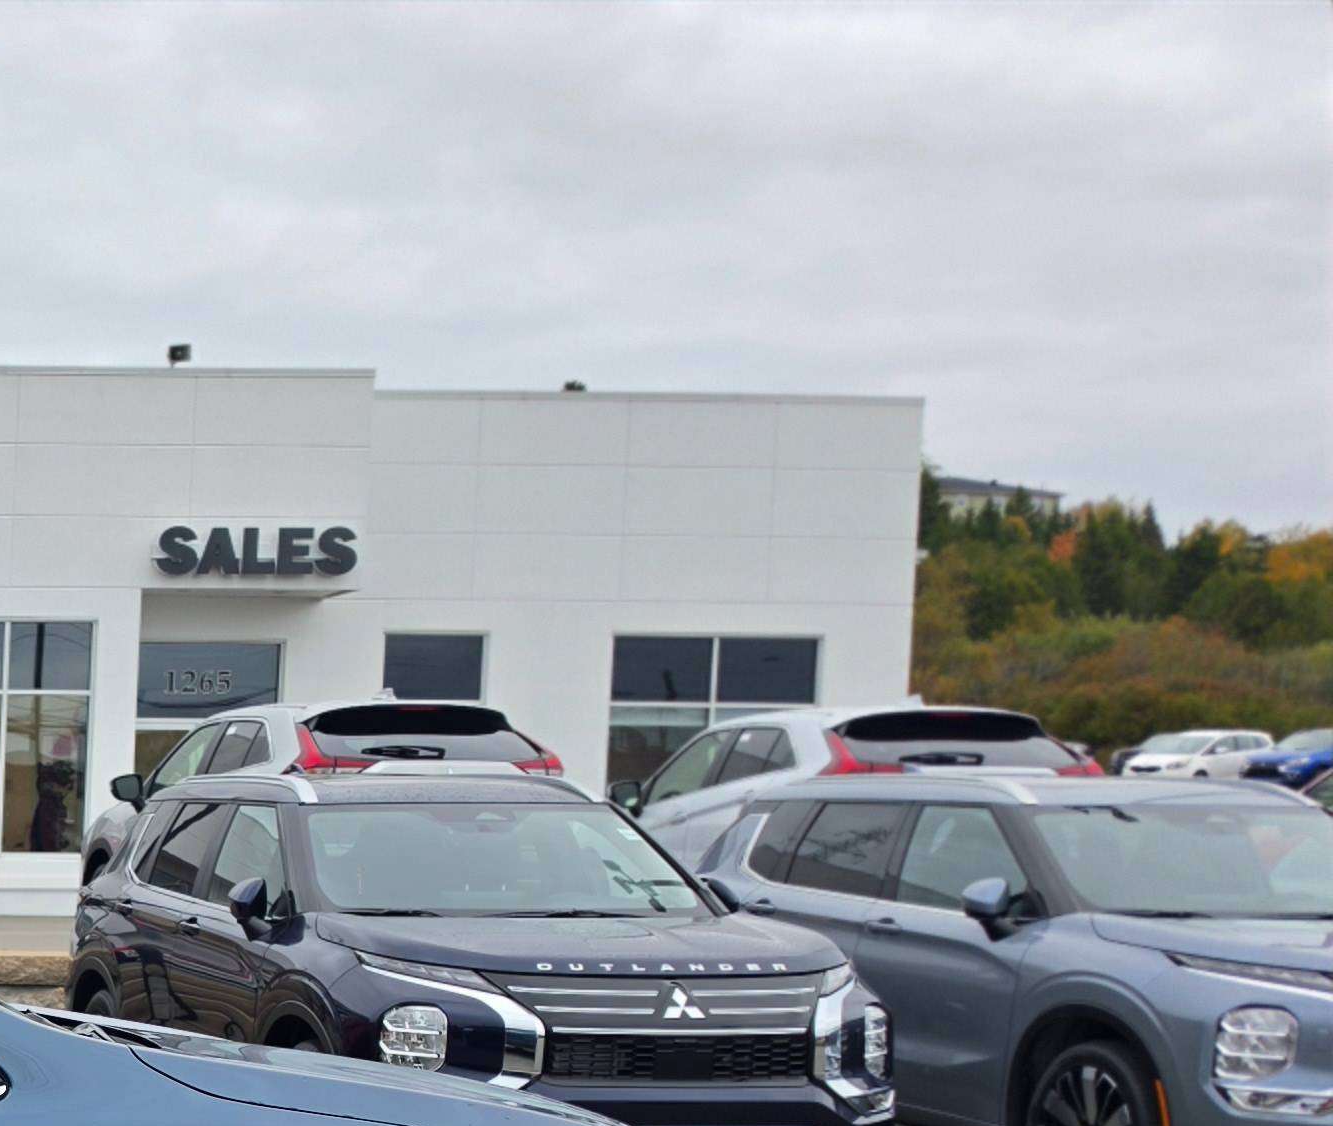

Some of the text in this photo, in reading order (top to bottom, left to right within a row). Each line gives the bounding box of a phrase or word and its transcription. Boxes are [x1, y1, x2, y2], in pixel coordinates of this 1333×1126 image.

[155, 525, 358, 576] SALES
[163, 669, 233, 695] 1265
[536, 962, 788, 972] OUTLANDER
